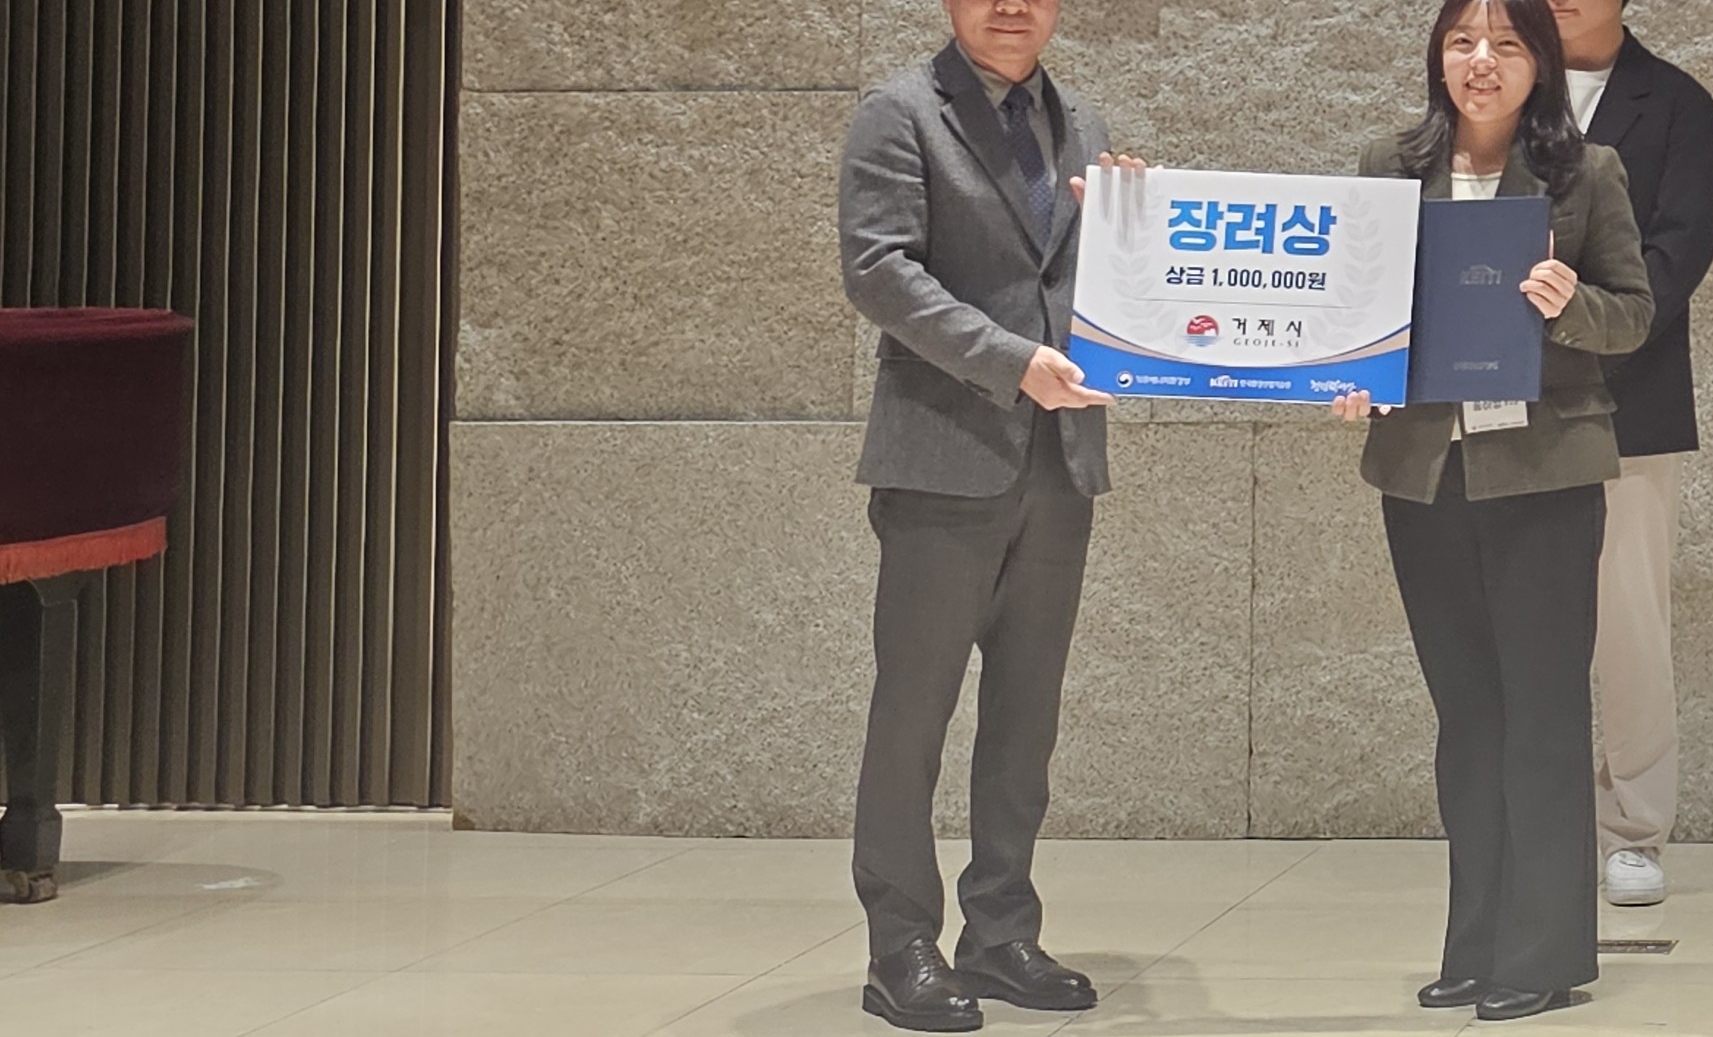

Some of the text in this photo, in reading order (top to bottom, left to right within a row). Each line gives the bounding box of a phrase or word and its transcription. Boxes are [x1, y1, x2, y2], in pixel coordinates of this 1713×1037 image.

[1168, 200, 1337, 256] 장려상
[1165, 266, 1327, 291] 상금 1,000,000원
